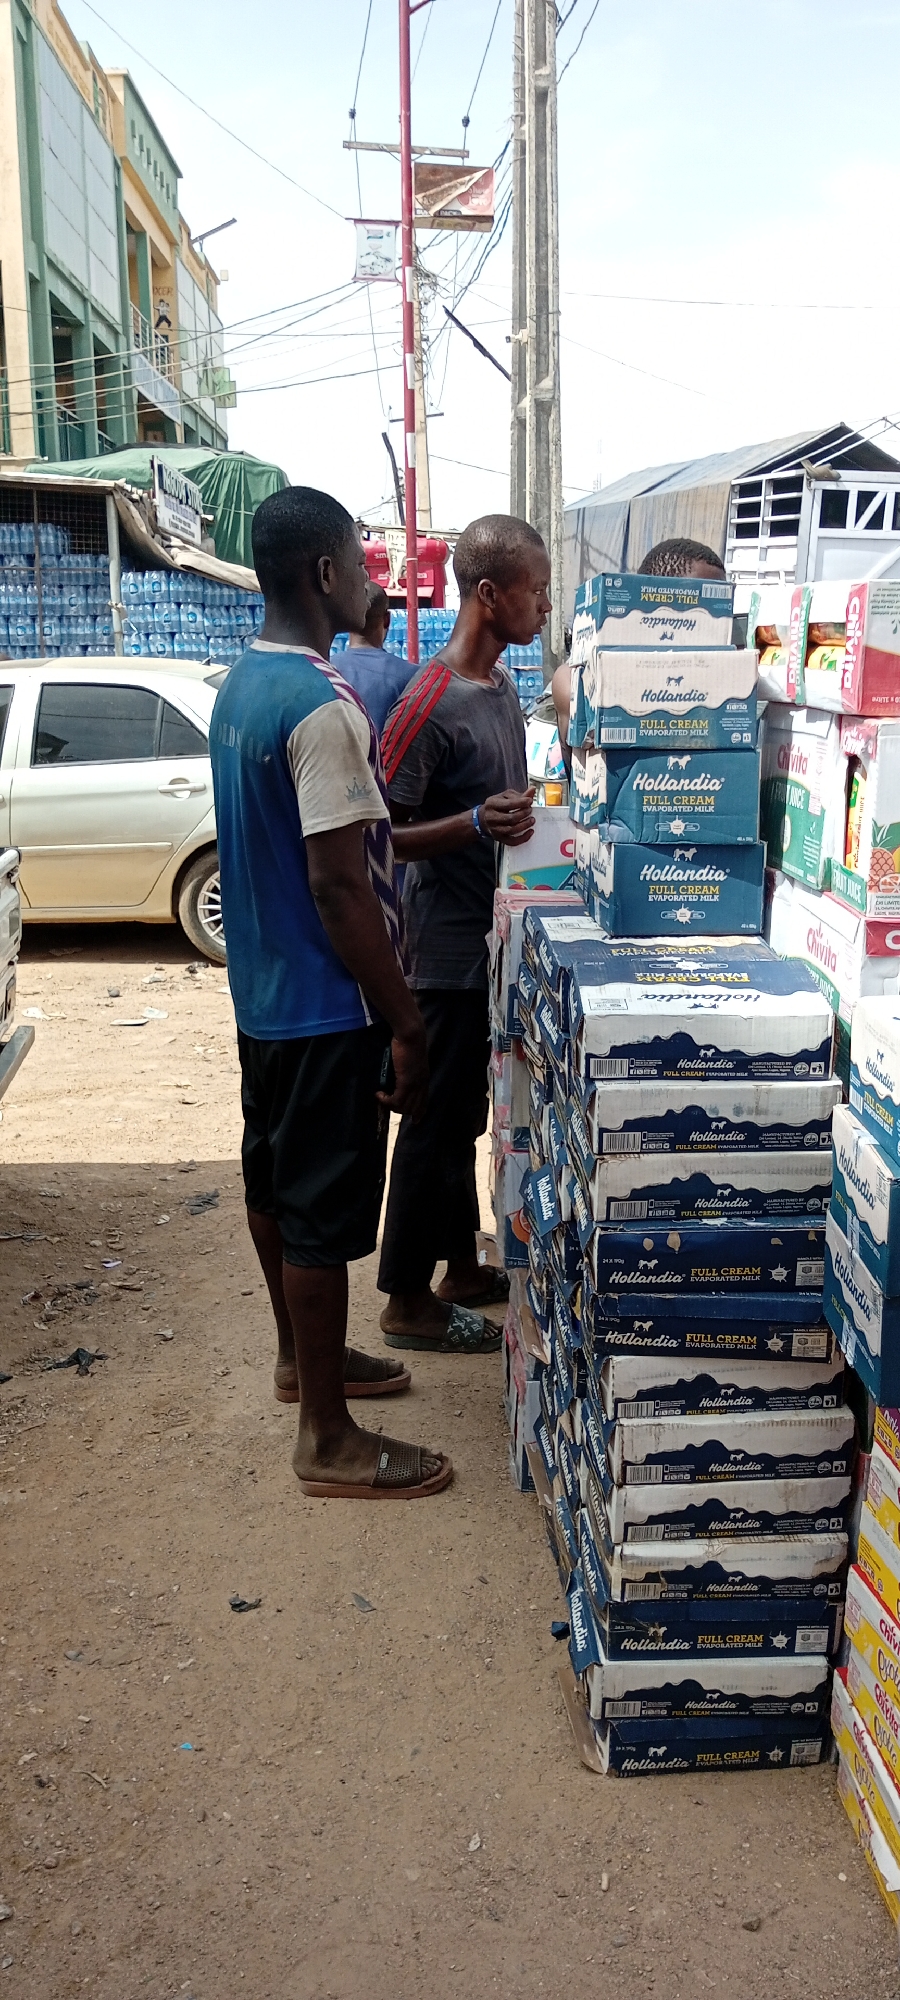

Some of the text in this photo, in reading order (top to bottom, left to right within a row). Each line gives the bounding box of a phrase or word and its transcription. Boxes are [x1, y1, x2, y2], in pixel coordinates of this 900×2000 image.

[640, 593, 675, 604] CREAM
[677, 595, 699, 605] FULL
[642, 616, 697, 631] Hollandia
[641, 689, 707, 703] Hollandia
[640, 719, 666, 729] FULL
[669, 719, 709, 729] CREAM
[689, 728, 709, 736] MILK
[632, 773, 723, 791] Hollandia
[643, 796, 715, 806] FULL CREAM
[642, 805, 693, 813] EVAPORATED
[639, 865, 728, 881] Hollandia
[649, 885, 720, 894] FULL CREAM
[648, 894, 720, 902] EVAPORATED MILK
[641, 993, 761, 1003] Hollandia
[677, 1058, 734, 1069] Hollandia
[865, 1055, 894, 1093] Hollandia
[689, 1131, 745, 1142] Hollandia
[838, 1145, 876, 1211] Hollandia
[537, 1173, 554, 1221] Hollandia
[695, 1198, 750, 1209] Hollandia
[609, 1271, 683, 1284] Hollandia
[691, 1267, 761, 1277] FULL CREAM
[834, 1250, 872, 1322] Hollandia
[605, 1331, 679, 1348] Hollandia
[686, 1333, 757, 1344] FULL CREAM
[699, 1397, 752, 1408] Hollandia
[587, 1416, 607, 1480] Hollandia
[708, 1463, 762, 1473] Hollandia
[708, 1520, 760, 1530] Hollandia
[581, 1531, 597, 1595] Hollandia
[706, 1582, 759, 1592] Hollandia
[570, 1587, 588, 1652] Hollandia
[621, 1638, 691, 1651] Hollandia
[697, 1634, 764, 1644] FULL CREAM
[685, 1700, 737, 1710] Hollandia
[621, 1759, 690, 1770] Hollandia
